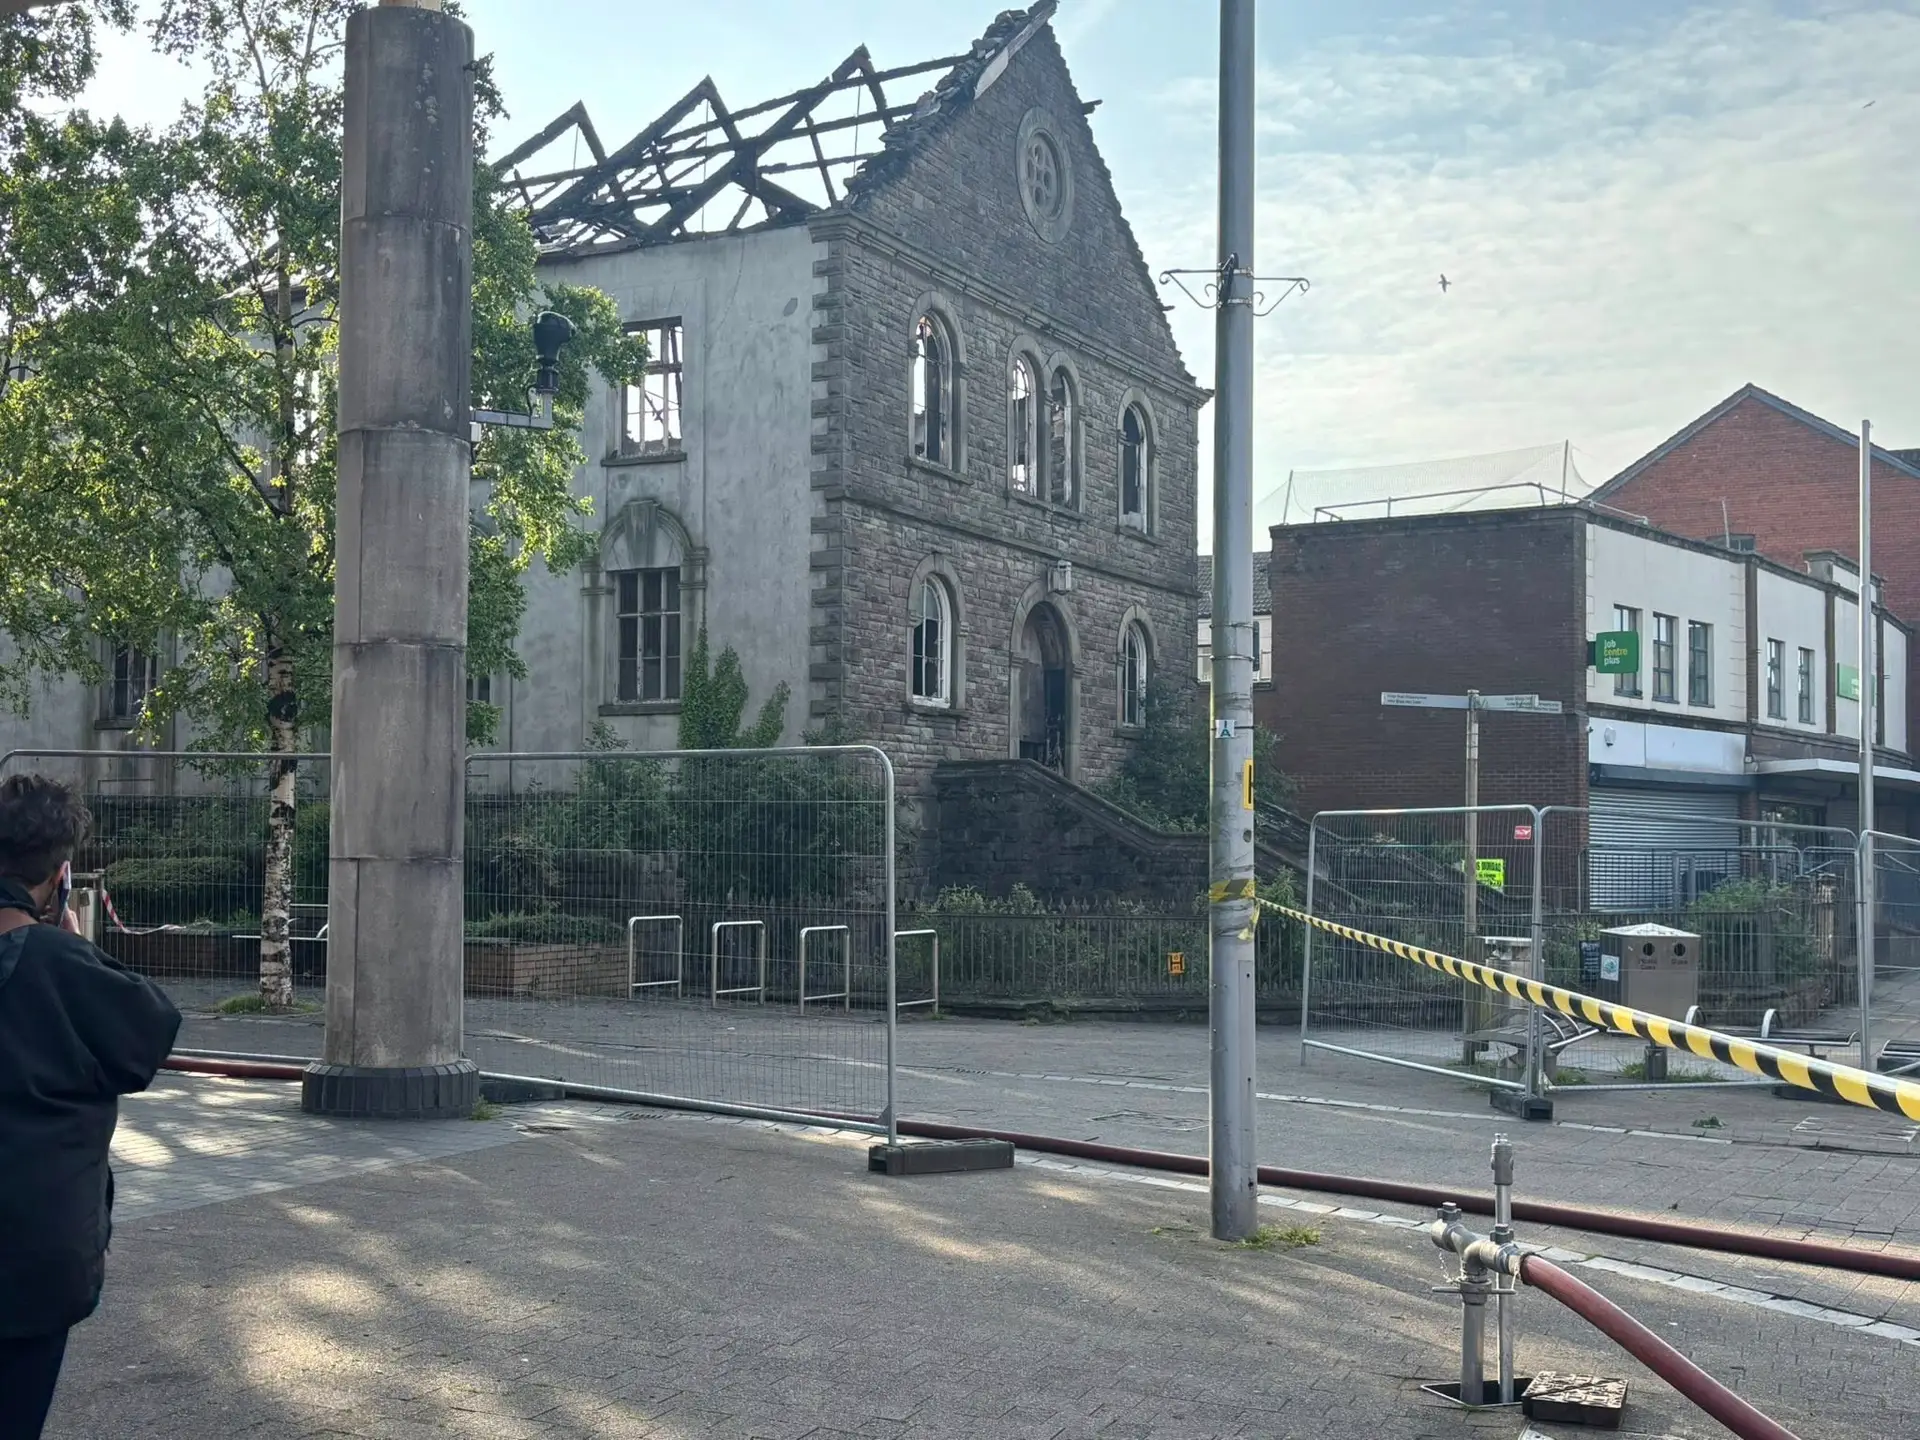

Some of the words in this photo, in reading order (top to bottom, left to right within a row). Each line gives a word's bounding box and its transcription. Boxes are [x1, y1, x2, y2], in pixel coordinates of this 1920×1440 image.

[1604, 640, 1617, 649] job
[1604, 648, 1628, 657] centre
[1604, 657, 1620, 666] plus
